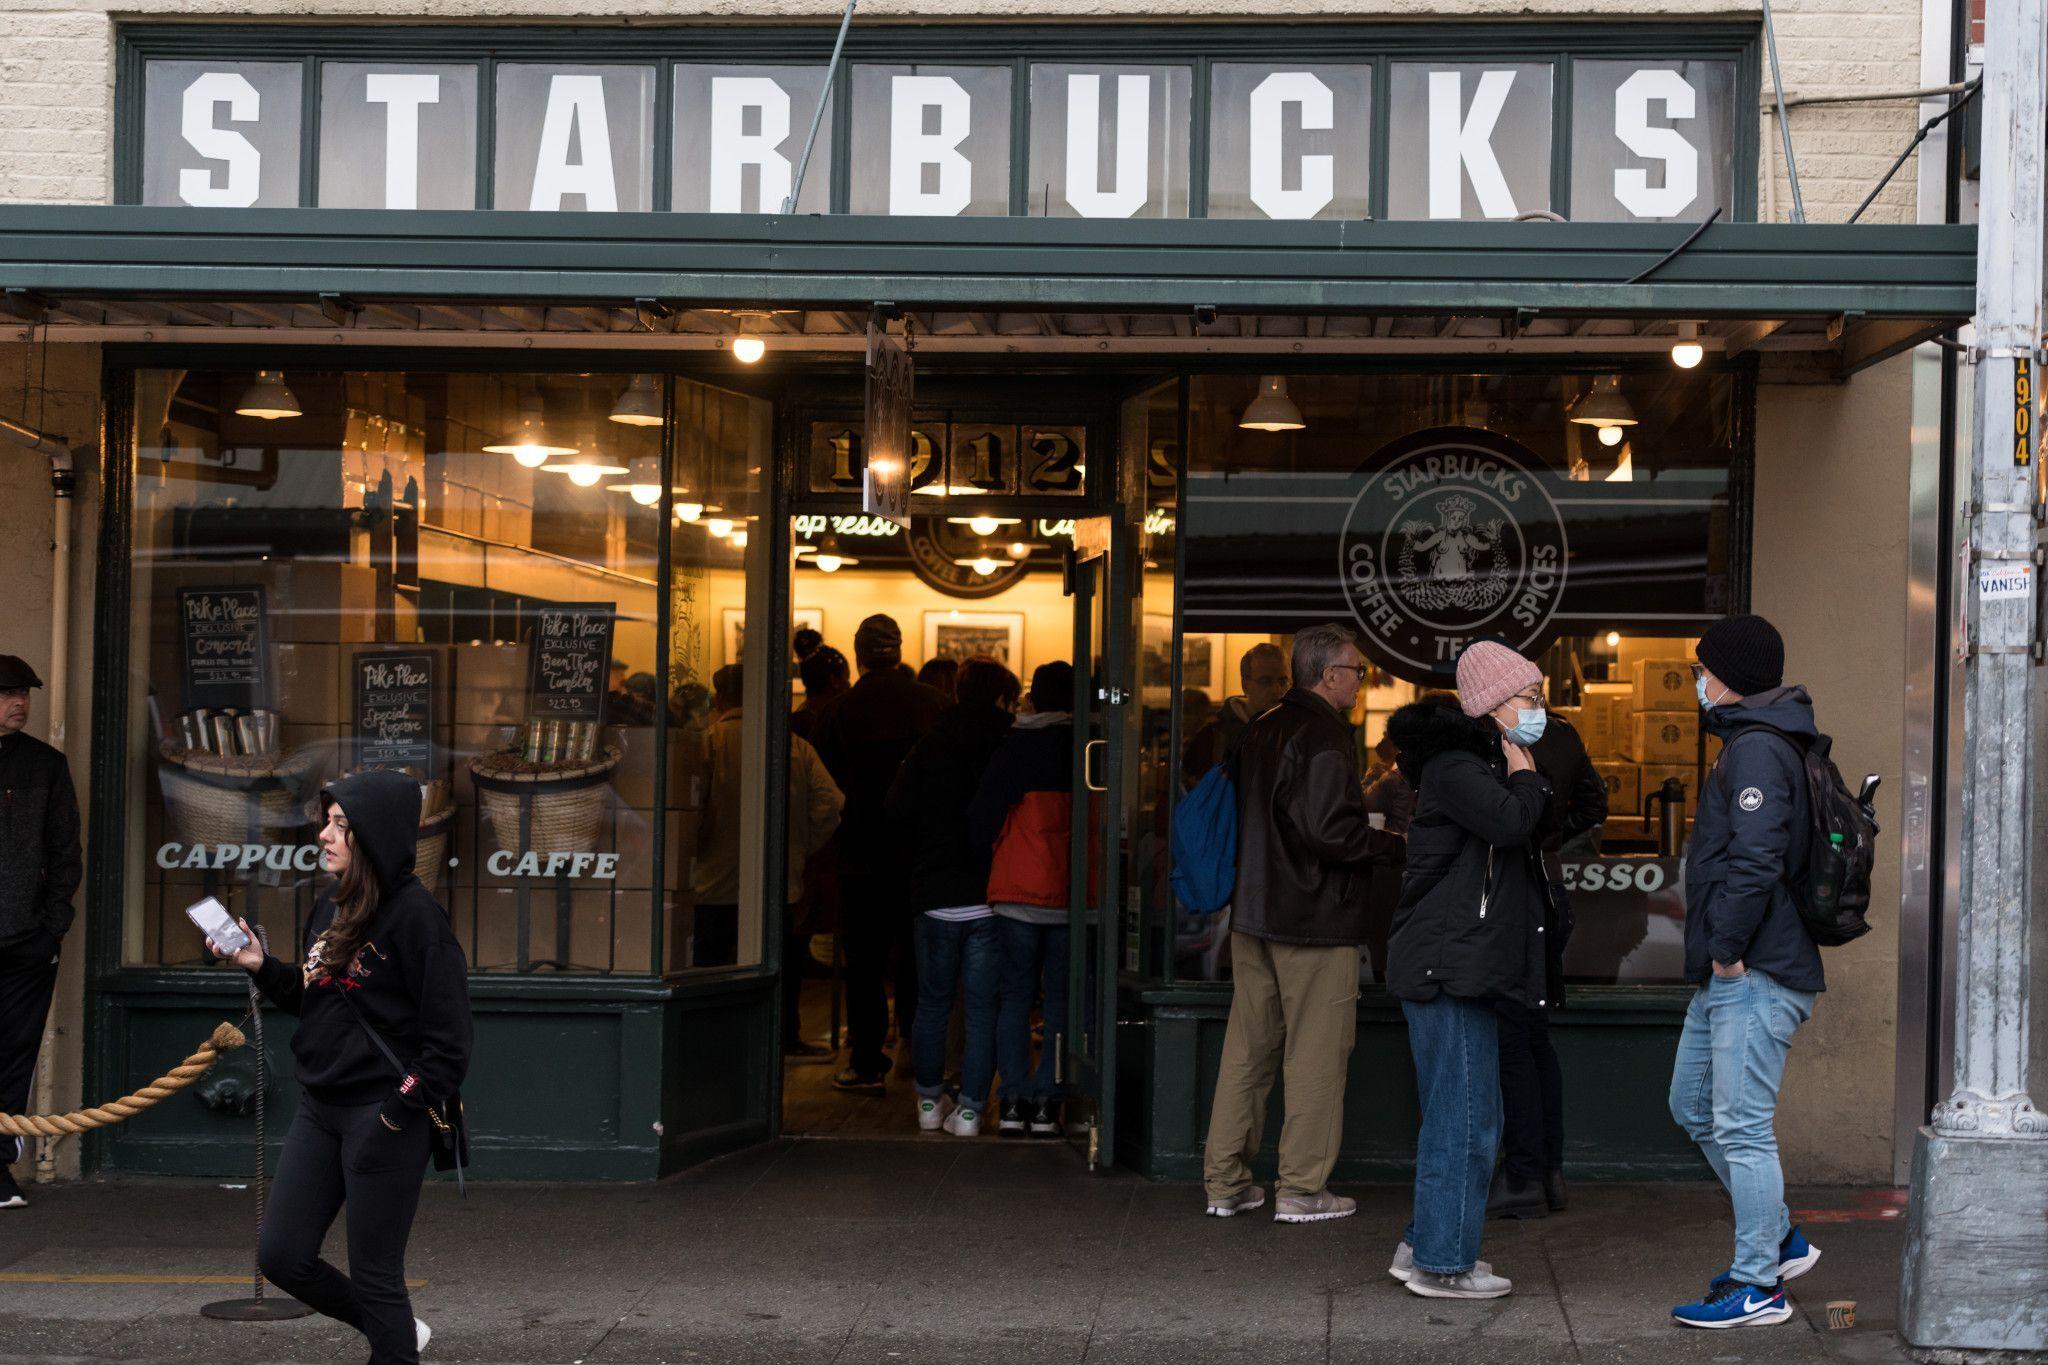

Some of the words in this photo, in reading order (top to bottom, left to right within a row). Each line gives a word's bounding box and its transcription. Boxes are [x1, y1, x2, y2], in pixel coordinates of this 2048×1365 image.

[179, 69, 1698, 220] STARBUCKS
[1383, 454, 1527, 502] STARBUCKS
[795, 515, 900, 539] spresso
[1349, 543, 1403, 637] COFFEE
[1512, 544, 1558, 628] SPICES
[186, 596, 221, 621] Pike
[221, 596, 257, 620] Place
[541, 612, 569, 636] Pike
[573, 613, 608, 637] Place
[195, 634, 256, 656] Concord
[544, 640, 598, 650] EXCLUSIVE
[1434, 635, 1473, 661] TE
[364, 664, 394, 690] Pike
[395, 664, 428, 687] Place
[369, 692, 419, 703] EXCLUSIVE
[363, 703, 409, 728] Special
[156, 842, 328, 870] CAPPUC
[487, 850, 620, 879] CAFFE
[1560, 863, 1665, 892] ESSO
